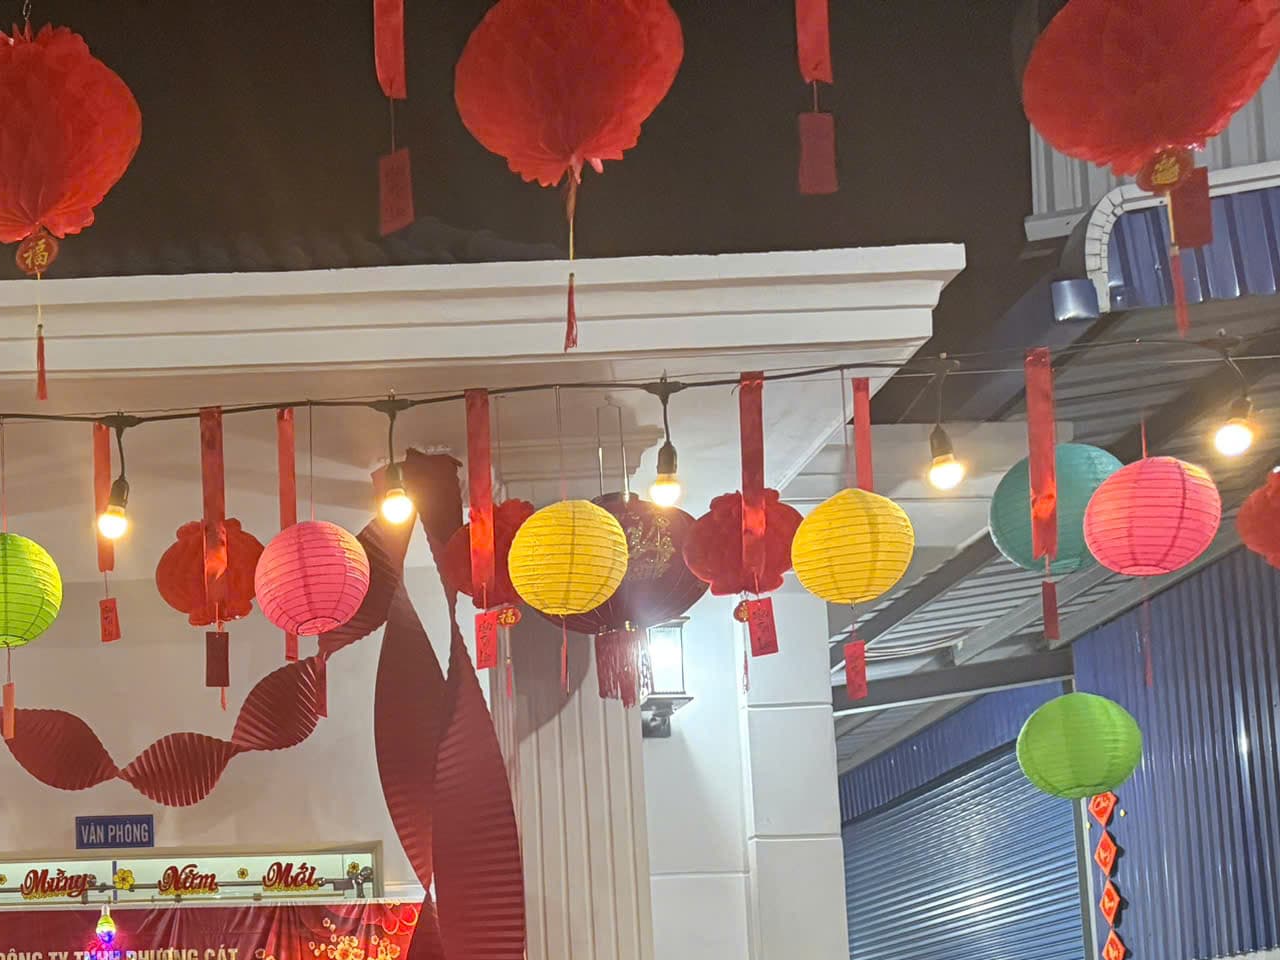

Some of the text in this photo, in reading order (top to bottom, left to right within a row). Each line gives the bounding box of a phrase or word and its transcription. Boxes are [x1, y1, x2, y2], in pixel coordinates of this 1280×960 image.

[23, 238, 49, 268] 福
[20, 867, 88, 898] Mừng
[157, 863, 218, 893] Năm
[262, 861, 321, 888] Mới
